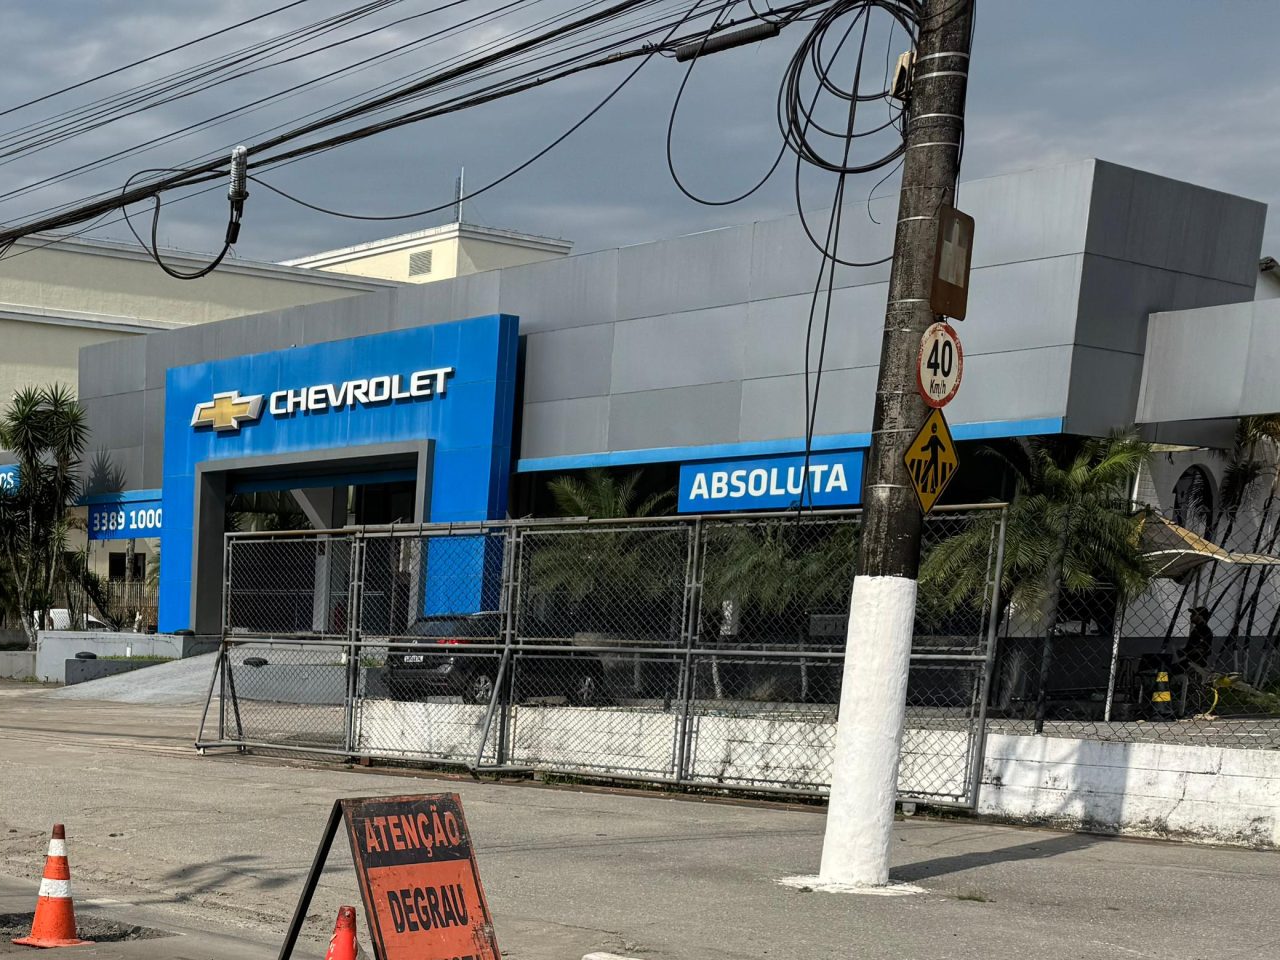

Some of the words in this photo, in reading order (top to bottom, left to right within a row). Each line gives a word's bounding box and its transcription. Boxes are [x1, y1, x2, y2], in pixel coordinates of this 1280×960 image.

[927, 339, 953, 378] 40
[270, 367, 455, 415] CHEVROLET
[689, 463, 848, 500] ABSOLUTA
[92, 510, 126, 532] 3389
[129, 508, 162, 529] 1000
[365, 804, 460, 858] ATENÇÃO
[387, 883, 469, 934] DEGRAU
